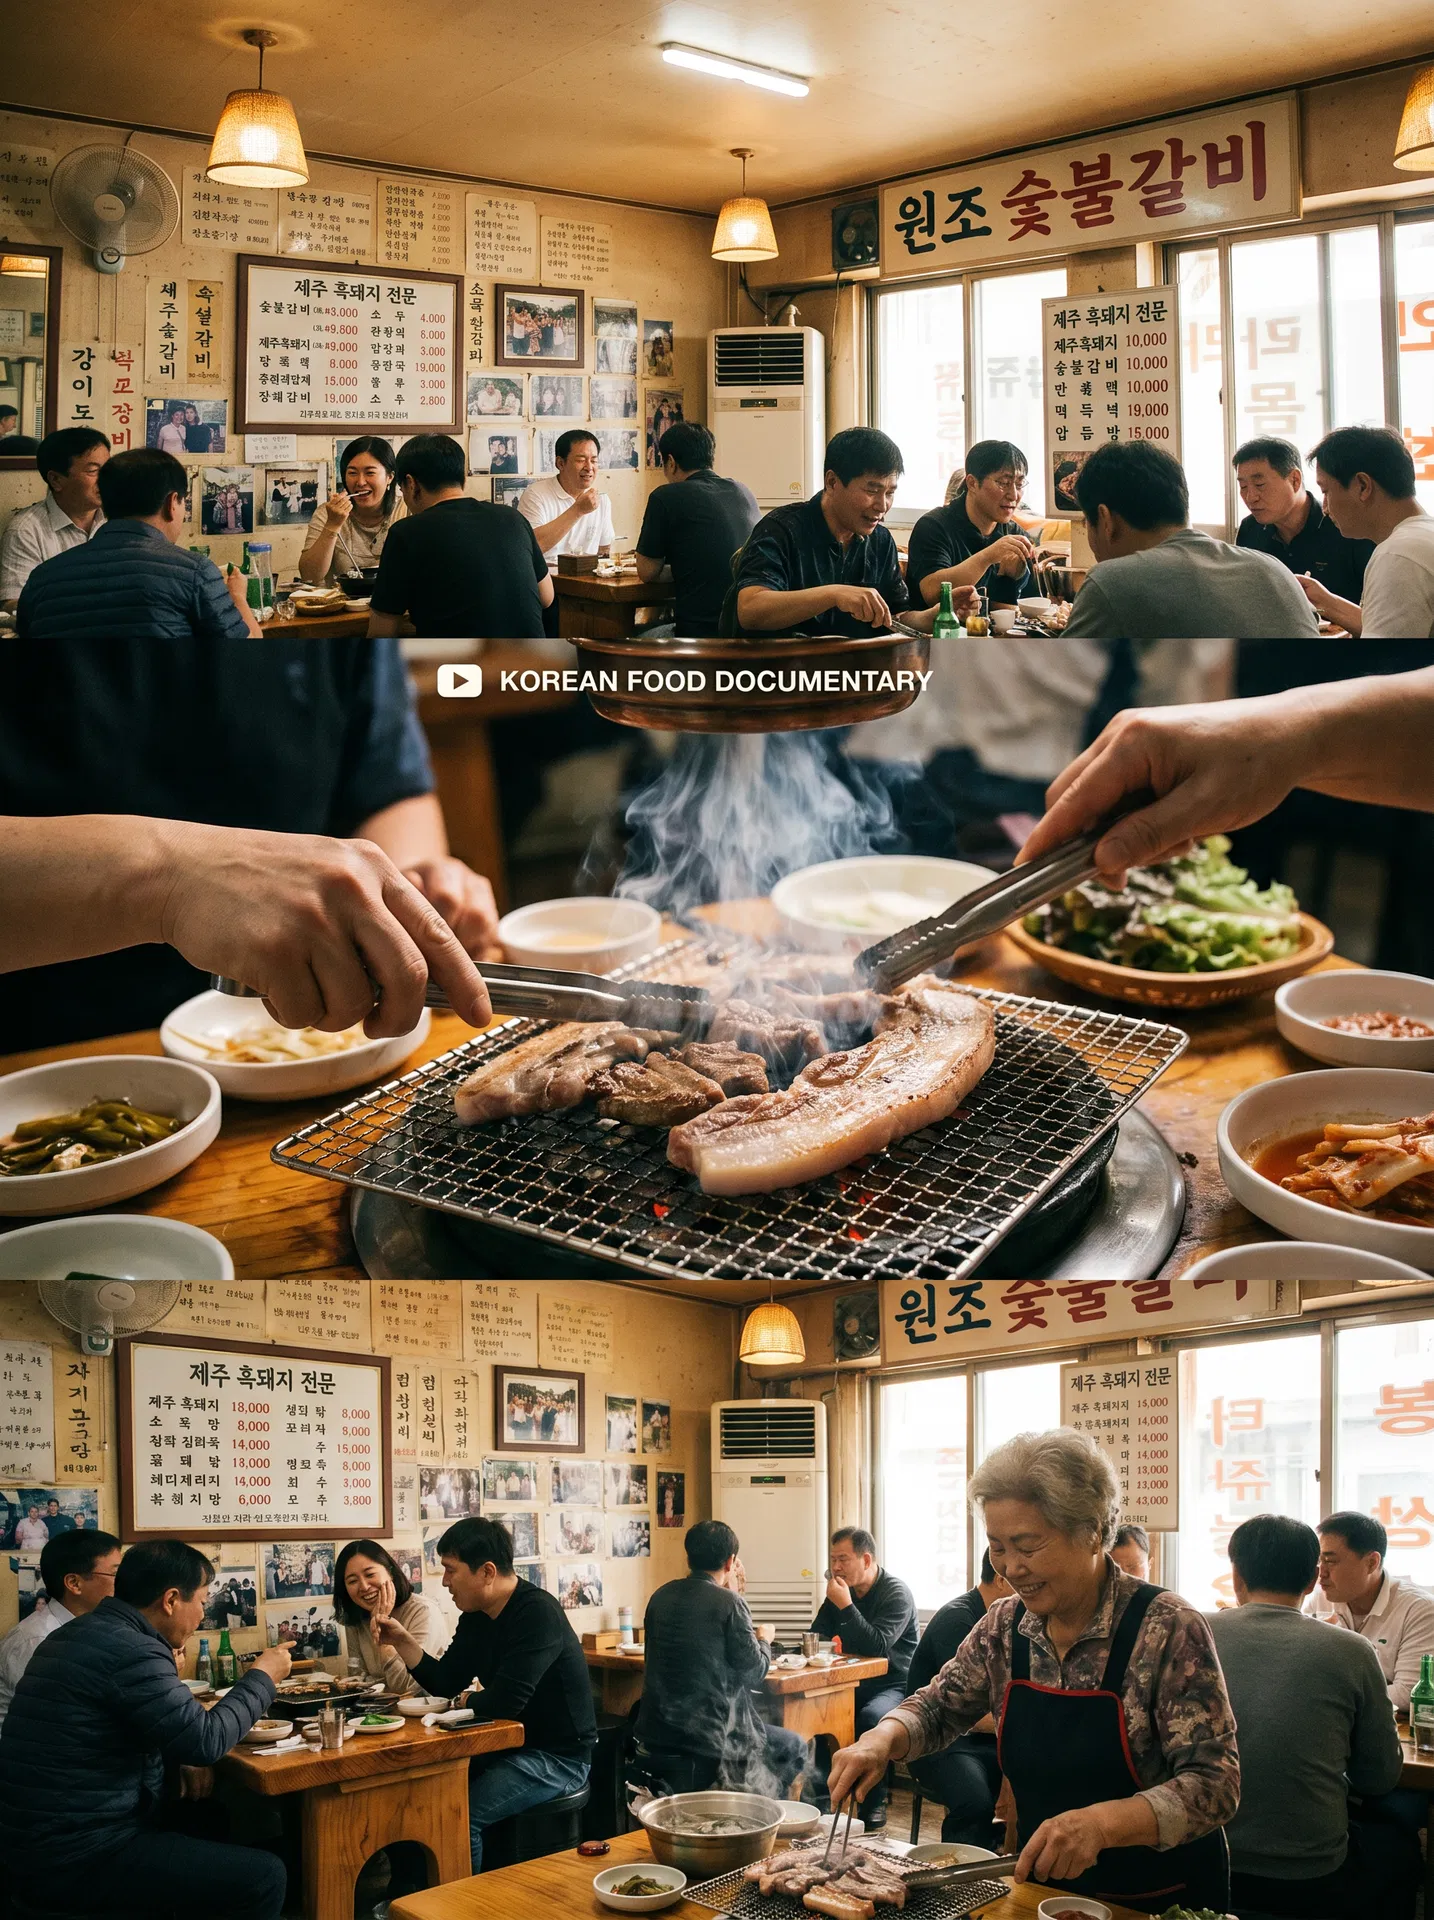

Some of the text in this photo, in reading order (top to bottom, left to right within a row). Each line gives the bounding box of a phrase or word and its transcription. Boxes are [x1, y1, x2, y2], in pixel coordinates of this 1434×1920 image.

[894, 120, 1267, 256] 원조 숯불갈비
[294, 278, 417, 305] 제주 흑돼지 전문
[1053, 300, 1168, 330] 제주 흑돼지 전문
[1054, 331, 1167, 354] 제주흑돼지 10,000
[894, 1281, 993, 1346] 원조
[189, 1361, 337, 1396] 제주 흑돼지 전문
[1070, 1367, 1172, 1392] 제주 흑돼지 전문
[148, 1395, 176, 1410] 제주
[232, 1401, 270, 1414] 18,000
[149, 1415, 163, 1427] 소
[237, 1420, 270, 1432] 8,000
[232, 1439, 270, 1451] 14,000
[343, 1478, 371, 1490] 3,000
[238, 1494, 271, 1506] 6,000
[343, 1495, 372, 1507] 3,800
